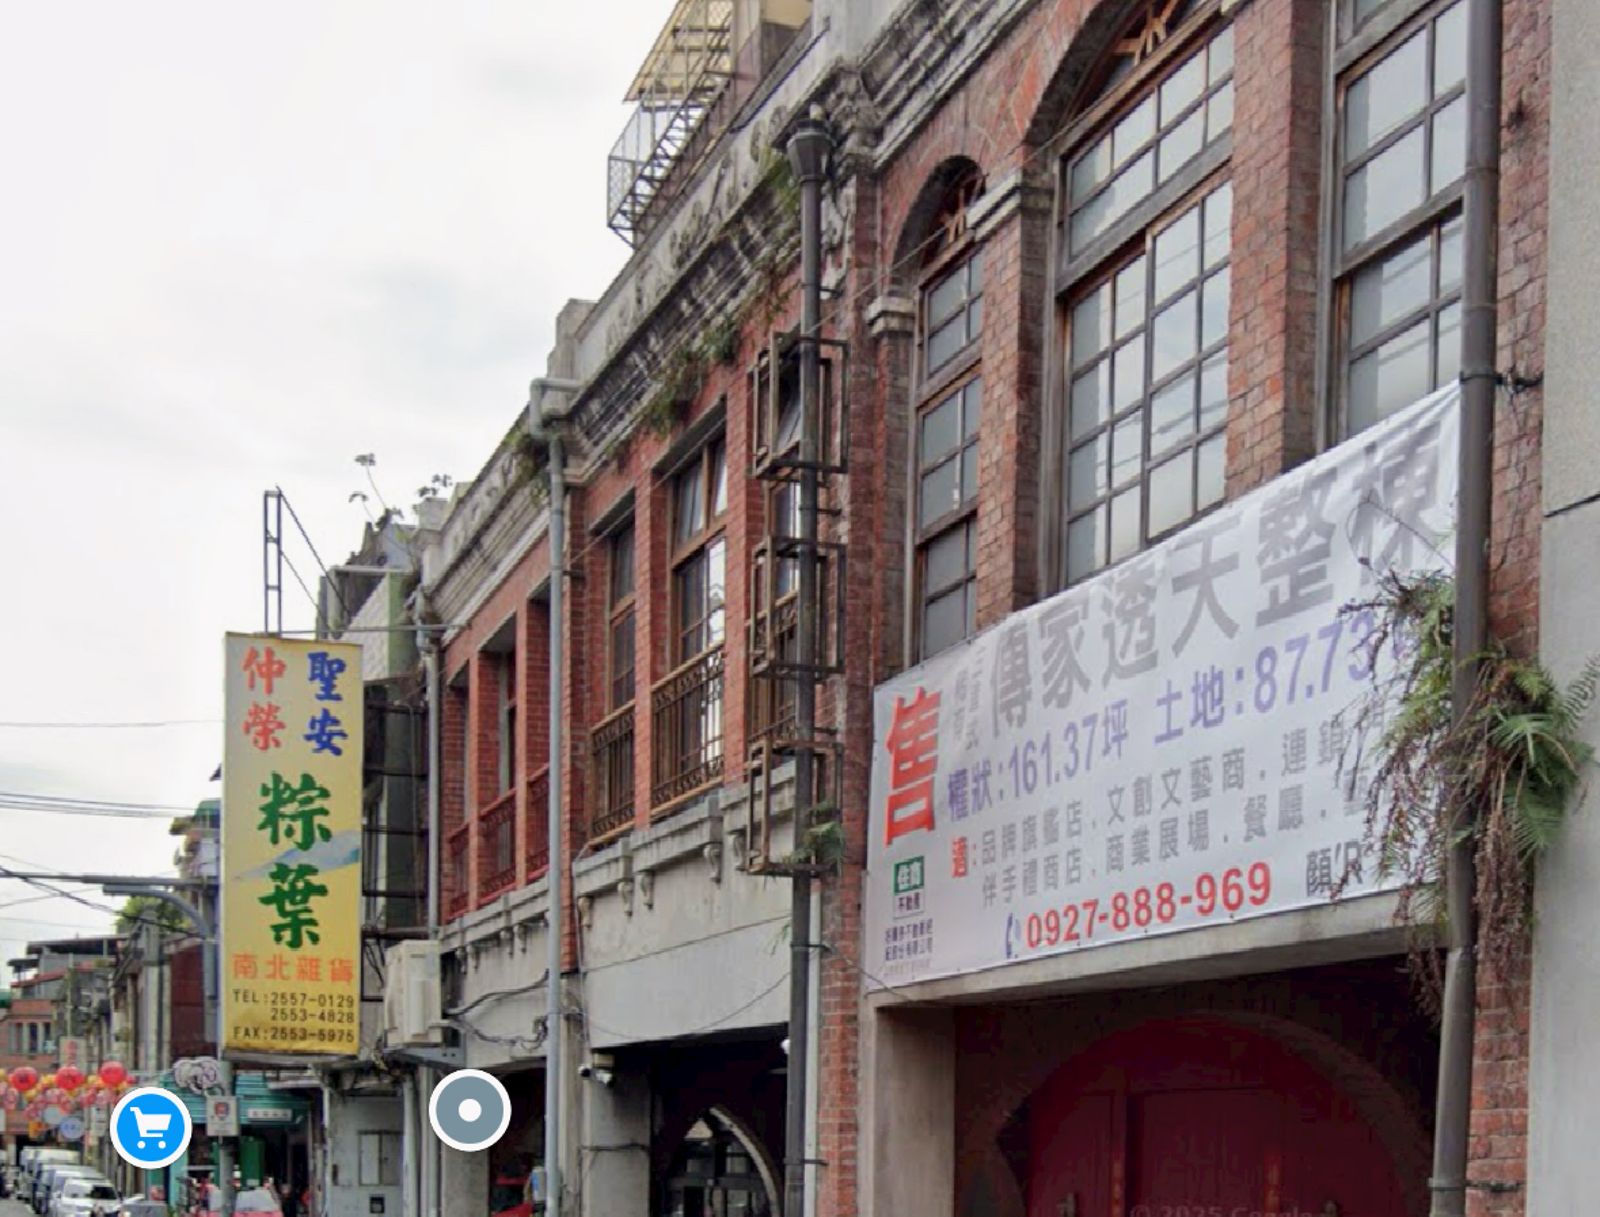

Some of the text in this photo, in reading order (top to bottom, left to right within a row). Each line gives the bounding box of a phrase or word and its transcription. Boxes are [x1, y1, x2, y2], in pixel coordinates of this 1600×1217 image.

[989, 420, 1442, 738] 傳家透天整棟
[242, 645, 287, 752] 仲榮
[303, 651, 348, 757] 聖安
[1154, 608, 1405, 744] 土地:87.73
[882, 685, 943, 847] 售
[257, 771, 333, 951] 粽葉
[1026, 861, 1272, 949] 0927-888-969
